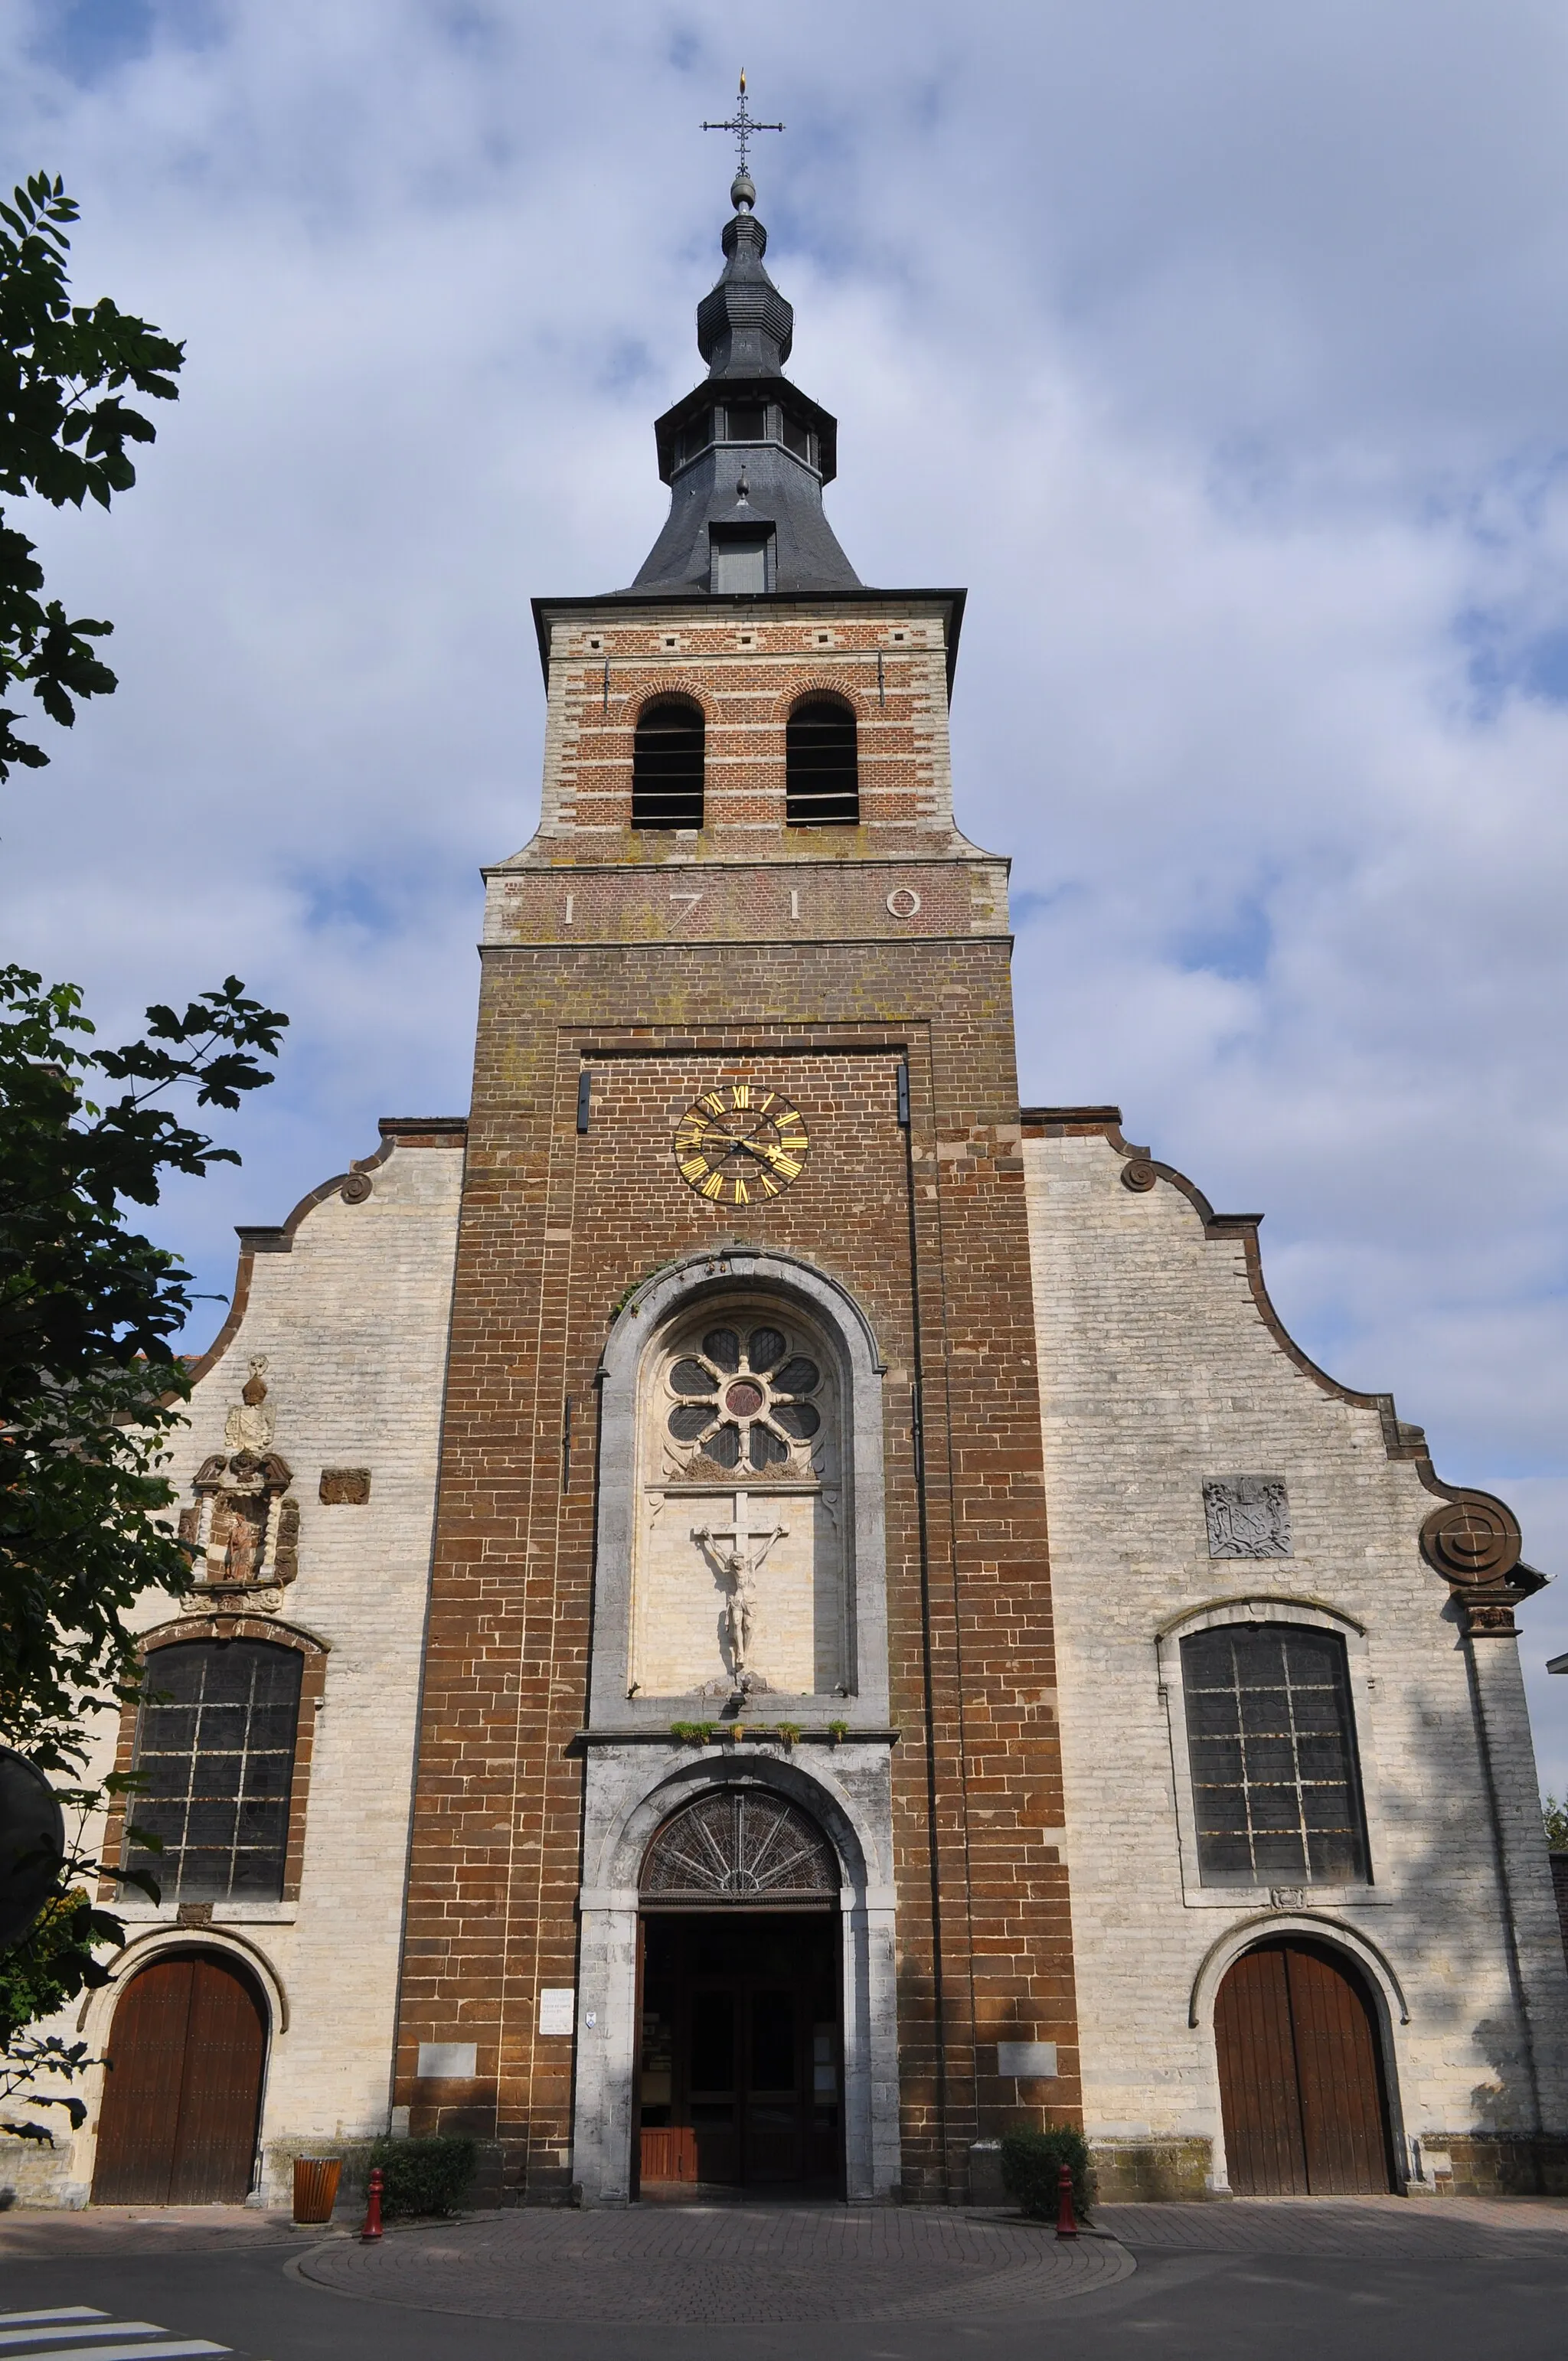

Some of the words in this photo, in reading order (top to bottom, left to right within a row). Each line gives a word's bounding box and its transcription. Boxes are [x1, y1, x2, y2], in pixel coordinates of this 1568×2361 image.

[704, 1092, 726, 1115] XI
[732, 1085, 749, 1109] XII
[760, 1092, 776, 1112] I
[775, 1111, 800, 1128] II
[781, 1137, 808, 1148] III
[701, 1172, 724, 1200] VII
[735, 1179, 749, 1203] VI
[760, 1174, 779, 1197] V
